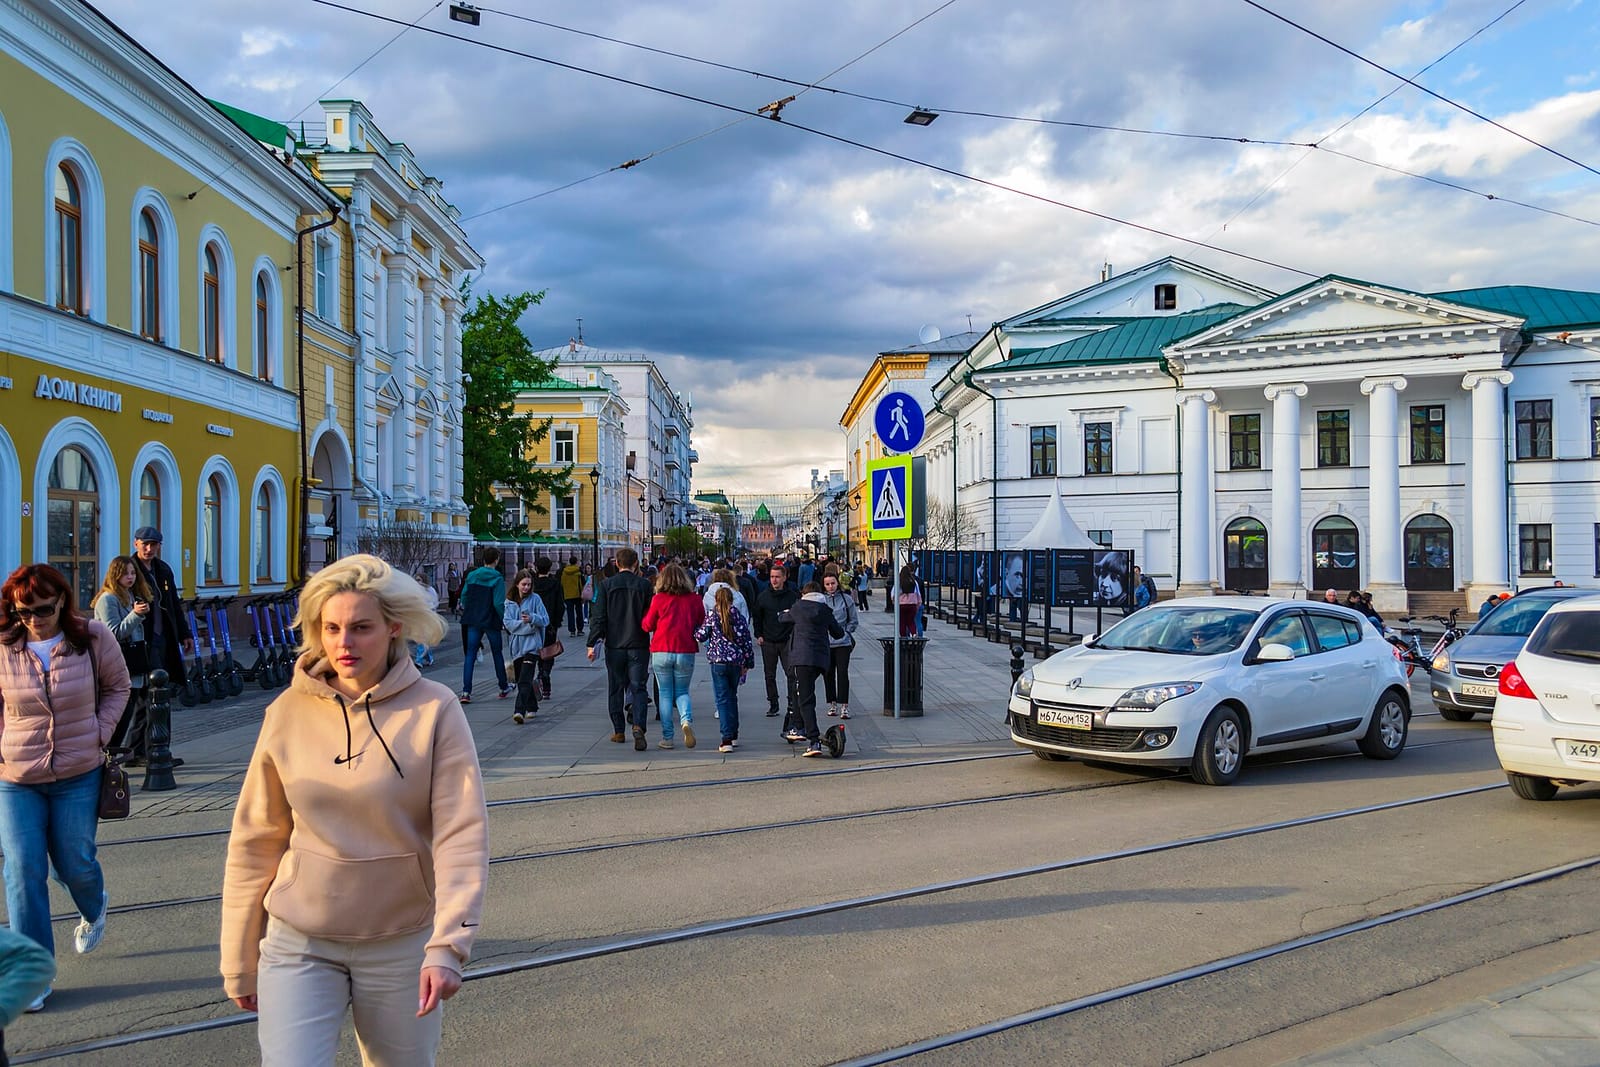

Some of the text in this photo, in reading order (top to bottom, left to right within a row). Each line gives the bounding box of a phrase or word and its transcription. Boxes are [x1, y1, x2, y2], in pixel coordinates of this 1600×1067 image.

[35, 374, 122, 413] ДОМ КНИГИ
[1040, 711, 1090, 725] М674ОМ 152
[1570, 744, 1600, 757] Х49
